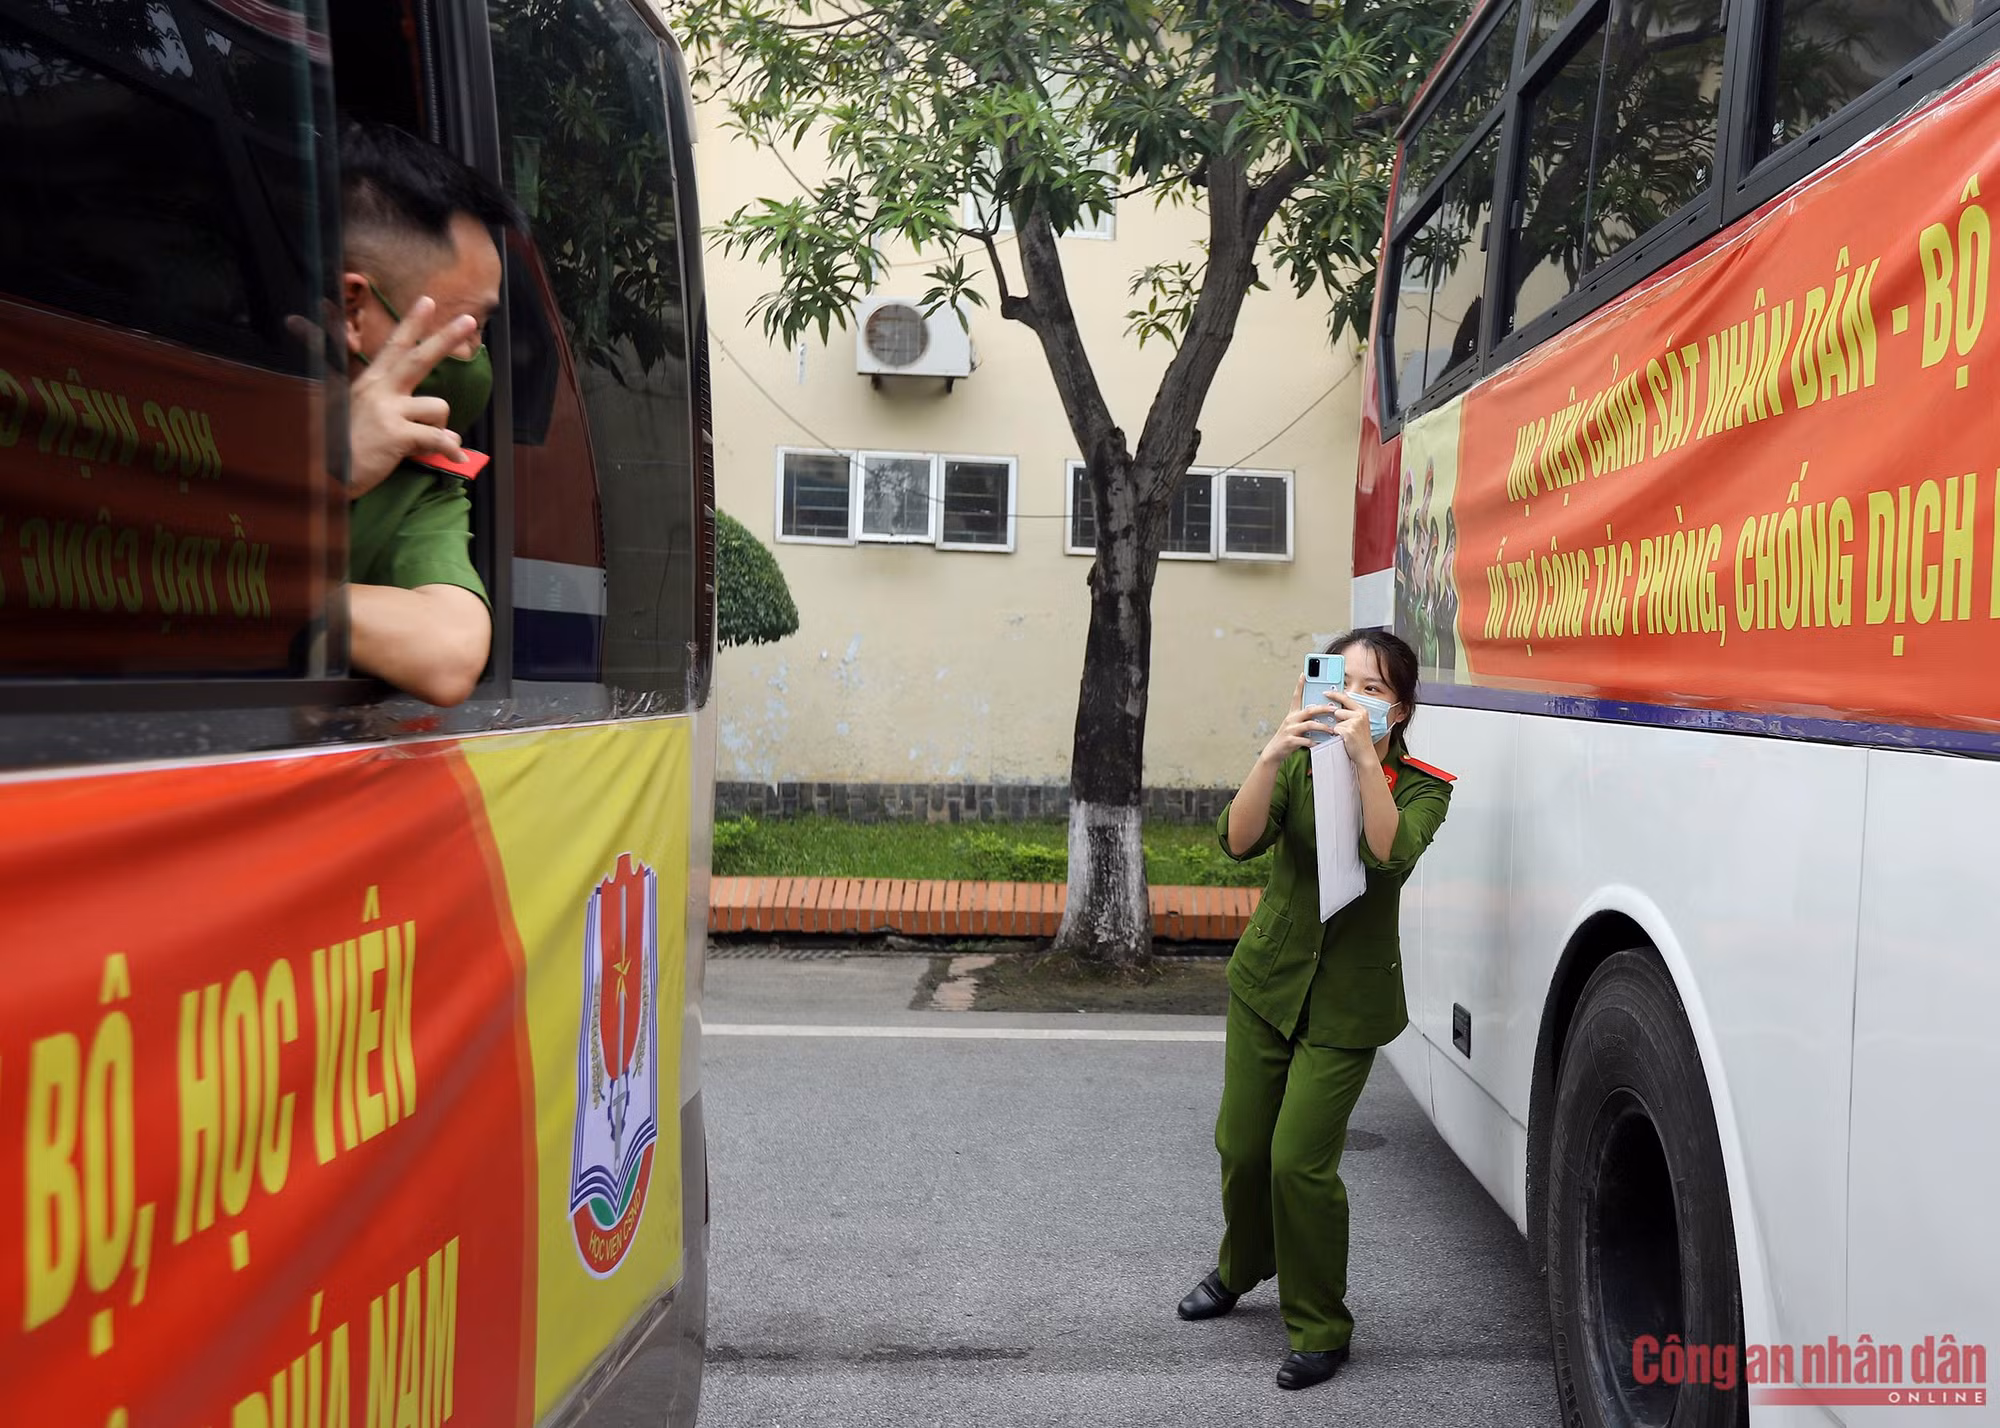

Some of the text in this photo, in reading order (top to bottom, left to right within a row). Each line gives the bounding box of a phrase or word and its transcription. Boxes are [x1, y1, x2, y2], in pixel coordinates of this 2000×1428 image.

[1506, 416, 1546, 517] HỌC
[1540, 386, 1589, 507] VIỆN
[1582, 353, 1647, 478] CẢNH
[1645, 332, 1700, 459] SÁT
[1695, 287, 1794, 440] NHÂN
[1790, 245, 1881, 409] DÂN
[1919, 172, 1991, 390] BỘ
[1484, 535, 1507, 639] HỖ
[1506, 549, 1539, 657] TRỢ
[1537, 536, 1590, 639] CÔNG
[1632, 505, 1727, 647] PHÒNG,
[1734, 461, 1854, 632] CHỐNG
[1865, 472, 1977, 657] DỊCH
[23, 885, 417, 1358] BỘ, HỌC VIÊN
[589, 1230, 606, 1264] HỌC
[623, 1188, 642, 1241] CSND
[367, 1235, 460, 1428] NAM
